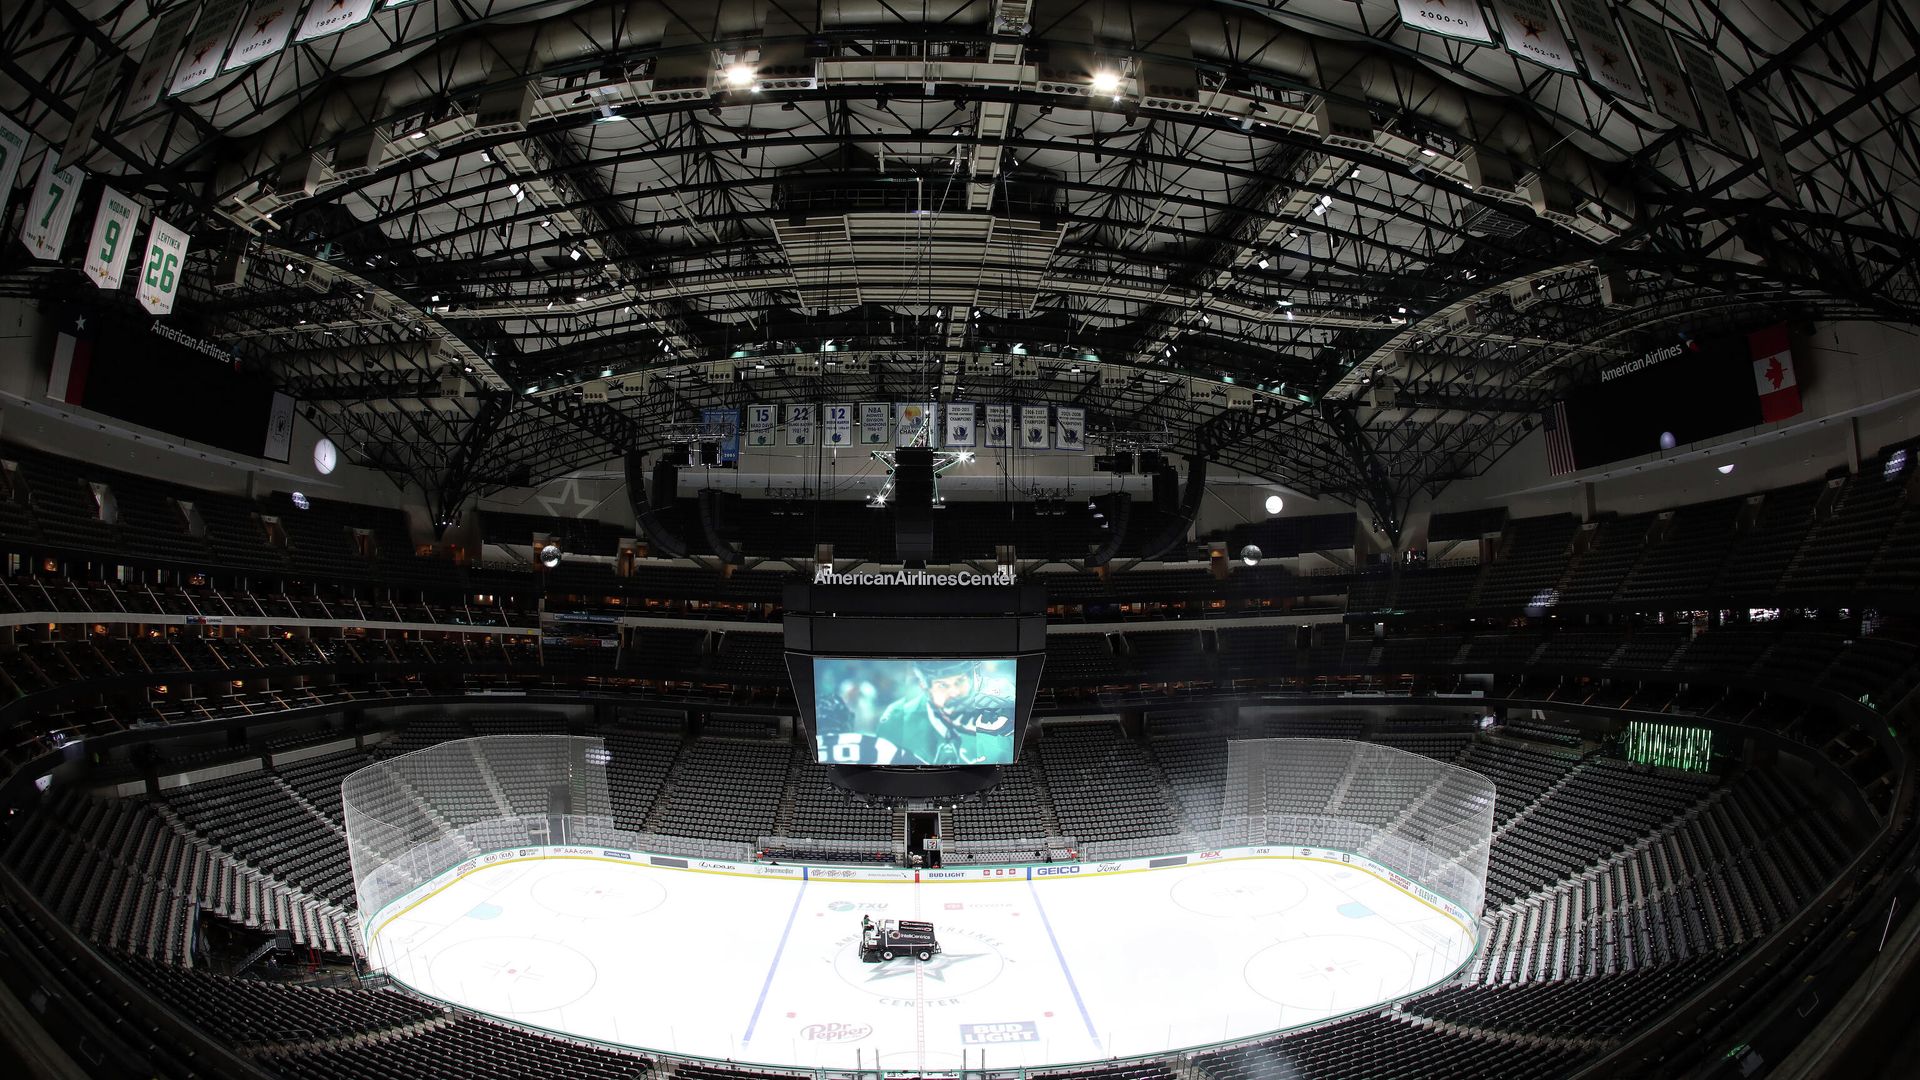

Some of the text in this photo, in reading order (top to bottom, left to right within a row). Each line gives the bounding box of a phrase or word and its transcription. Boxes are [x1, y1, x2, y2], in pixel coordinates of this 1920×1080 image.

[316, 12, 353, 28] 1998-99
[1420, 11, 1468, 27] 2000-01
[242, 38, 272, 54] 1997-98
[1522, 42, 1561, 60] 2002-03
[41, 183, 64, 229] 7
[108, 198, 131, 219] MODANO
[100, 219, 121, 263] 9
[157, 232, 181, 251] LEHTINEN
[145, 244, 179, 293] 26
[150, 319, 231, 364] American Airlines
[1601, 343, 1682, 383] American Airlines
[756, 410, 769, 422] 15
[794, 408, 809, 420] 22
[831, 408, 846, 419] 12
[1200, 850, 1220, 858] DEX
[1037, 866, 1080, 875] GEICO
[1096, 863, 1122, 872] Ford
[937, 926, 1003, 947] IRLINES
[879, 998, 960, 1007] CENTER
[808, 1024, 868, 1041] Pepper
[827, 1022, 852, 1031] Dr
[973, 1024, 1023, 1034] BUD
[965, 1031, 1034, 1043] LIGHT
